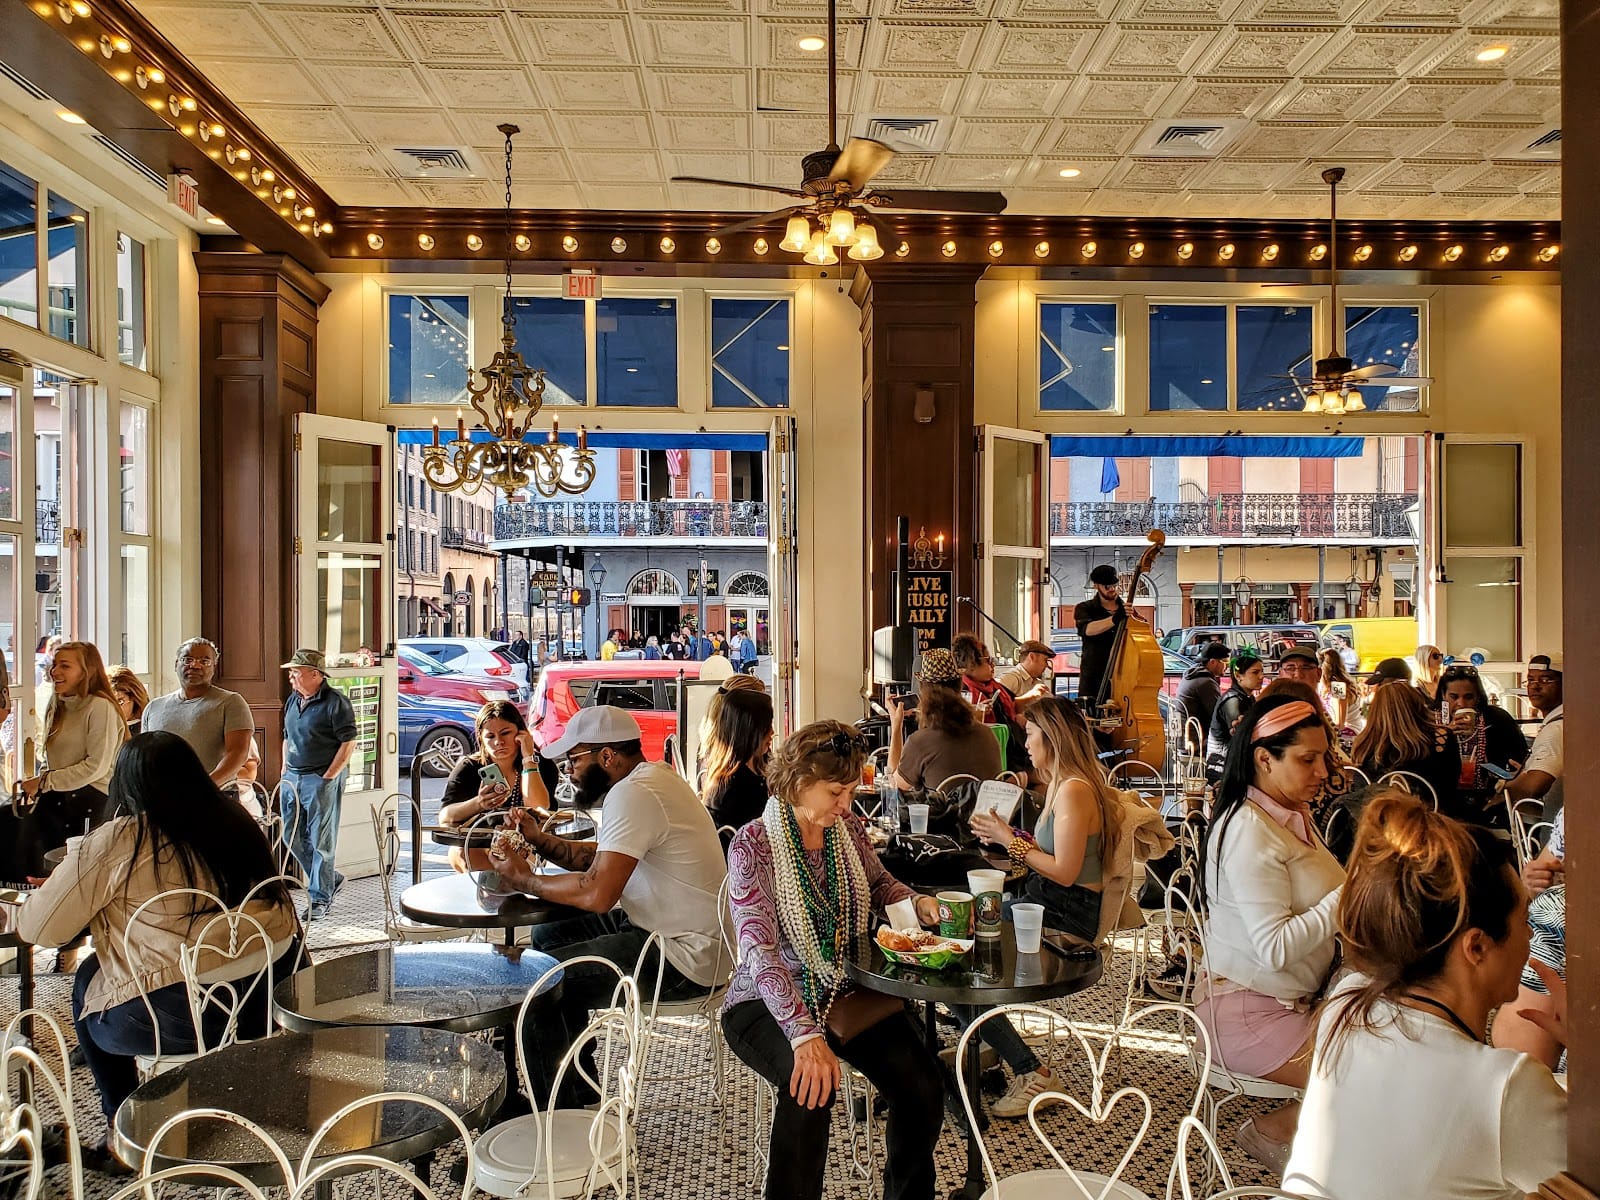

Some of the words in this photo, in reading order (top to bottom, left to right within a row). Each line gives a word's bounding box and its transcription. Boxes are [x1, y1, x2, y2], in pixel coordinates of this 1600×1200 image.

[178, 181, 196, 217] EXIT
[568, 276, 597, 297] EXIT
[907, 609, 947, 623] AILY
[917, 628, 936, 639] PM
